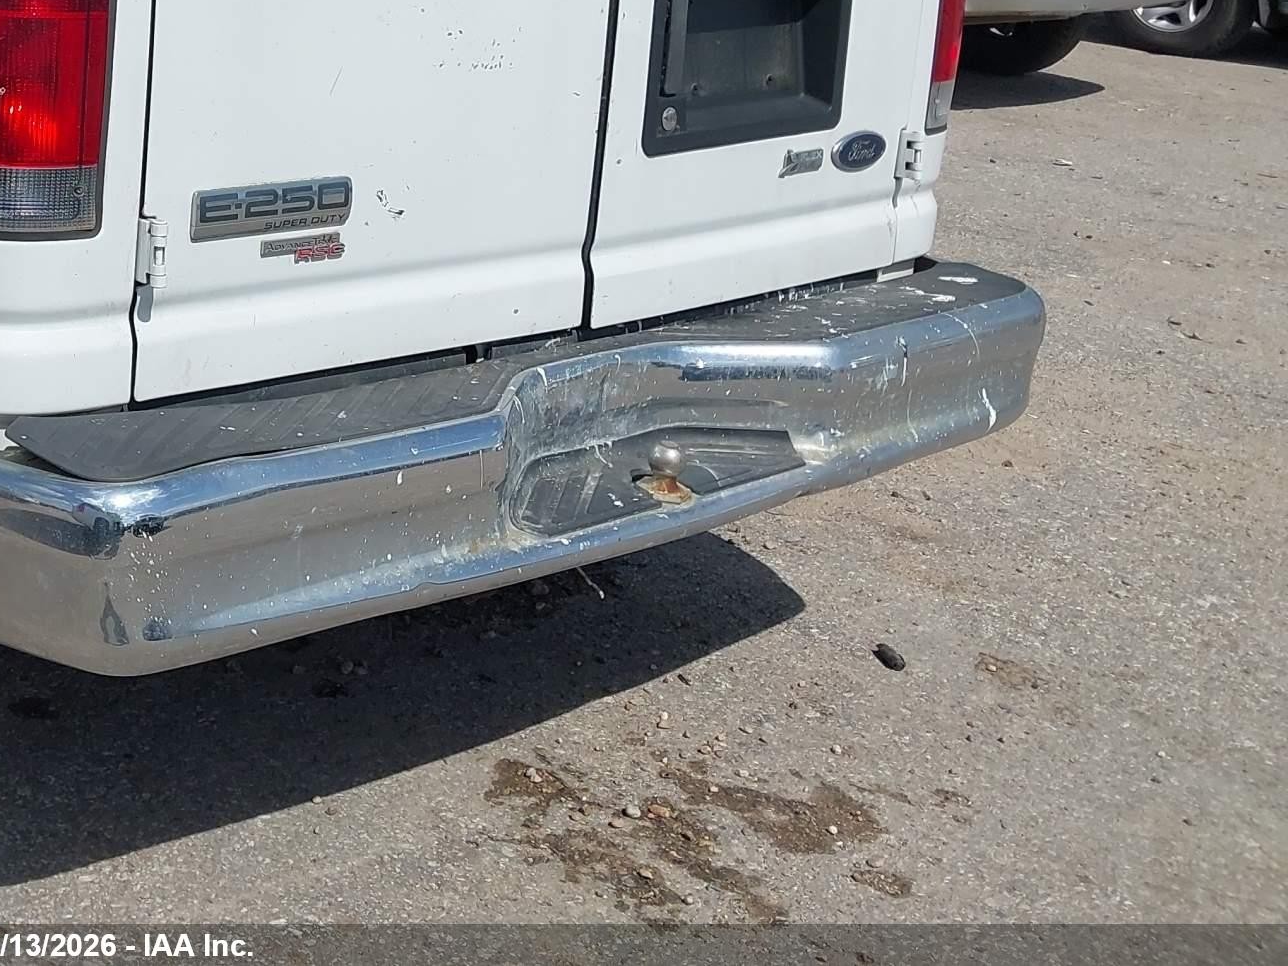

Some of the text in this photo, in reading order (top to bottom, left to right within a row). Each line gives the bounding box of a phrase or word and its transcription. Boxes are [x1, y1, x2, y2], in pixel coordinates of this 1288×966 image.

[847, 139, 877, 162] Ford
[264, 212, 347, 230] SUPER DUTY
